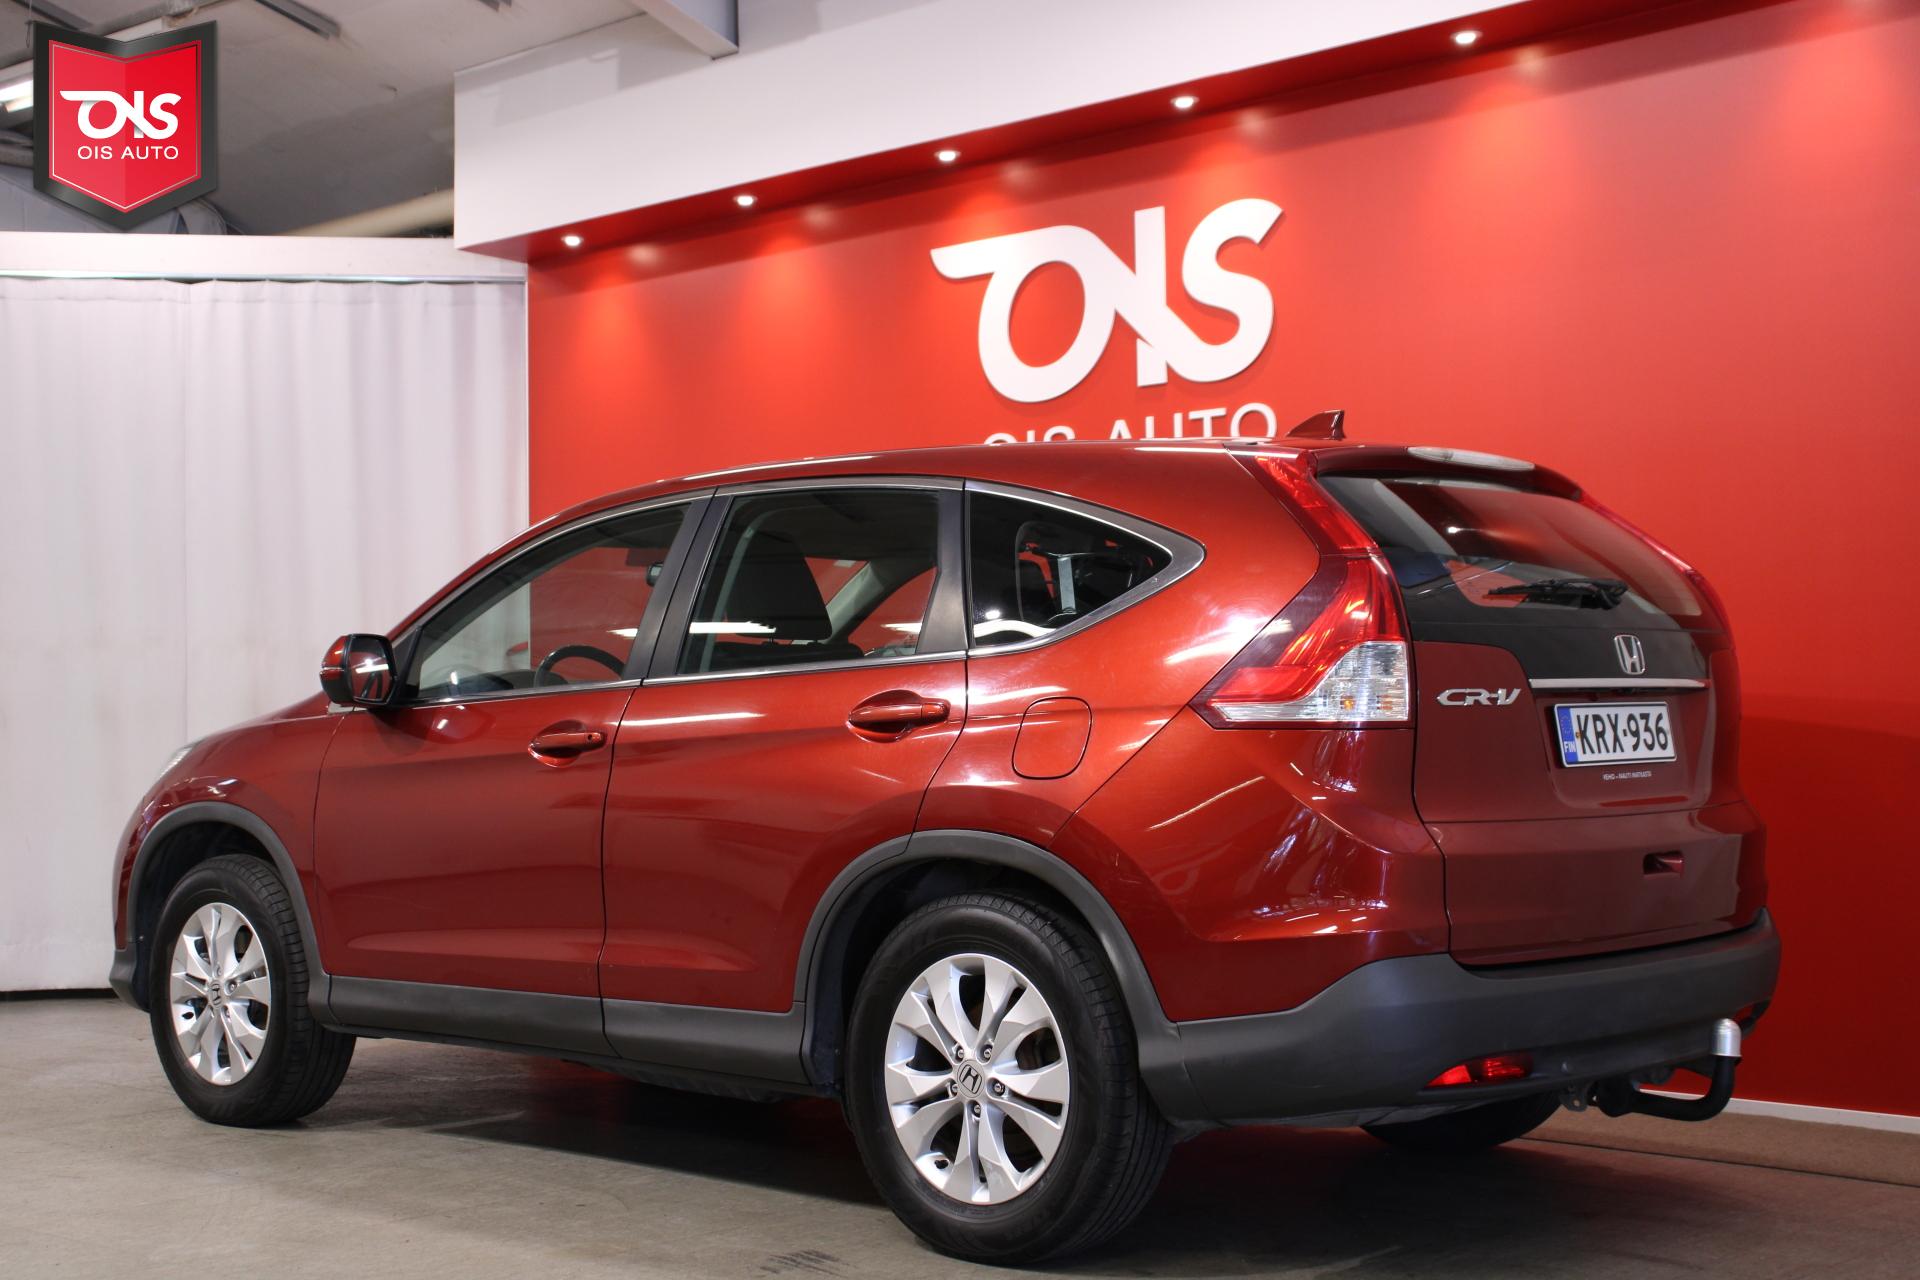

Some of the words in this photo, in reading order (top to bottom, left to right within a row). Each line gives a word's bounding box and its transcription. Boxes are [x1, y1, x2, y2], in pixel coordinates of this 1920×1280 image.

[930, 197, 1283, 403] OIS
[1436, 687, 1522, 706] CR-V
[1563, 740, 1577, 753] FIN
[1576, 712, 1669, 755] KRX-936
